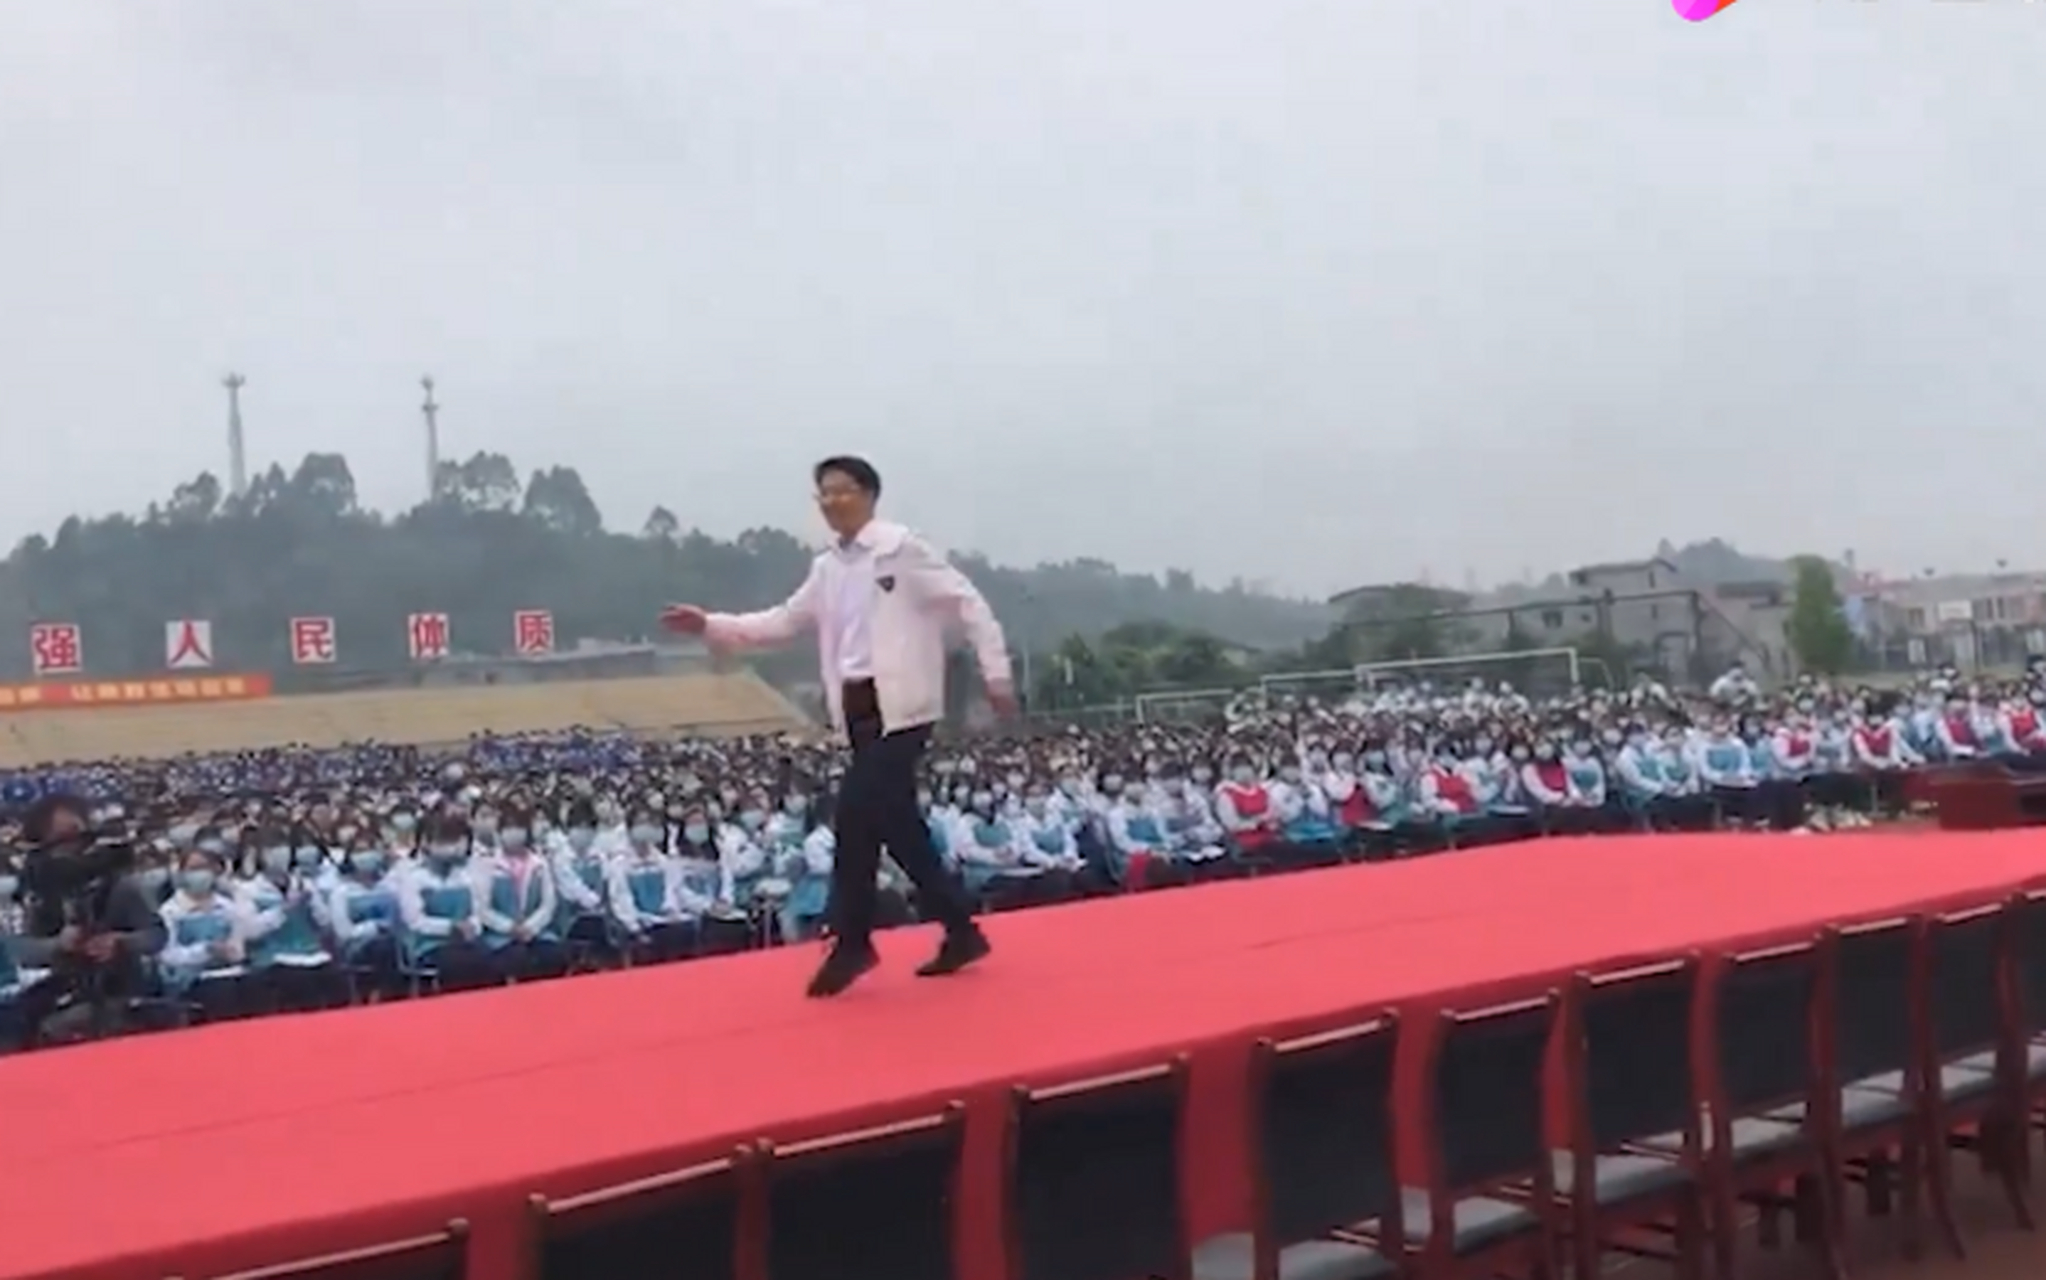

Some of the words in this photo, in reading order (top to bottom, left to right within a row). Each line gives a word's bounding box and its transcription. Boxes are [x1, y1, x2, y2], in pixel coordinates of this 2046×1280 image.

[31, 611, 554, 672] 强人民体质
